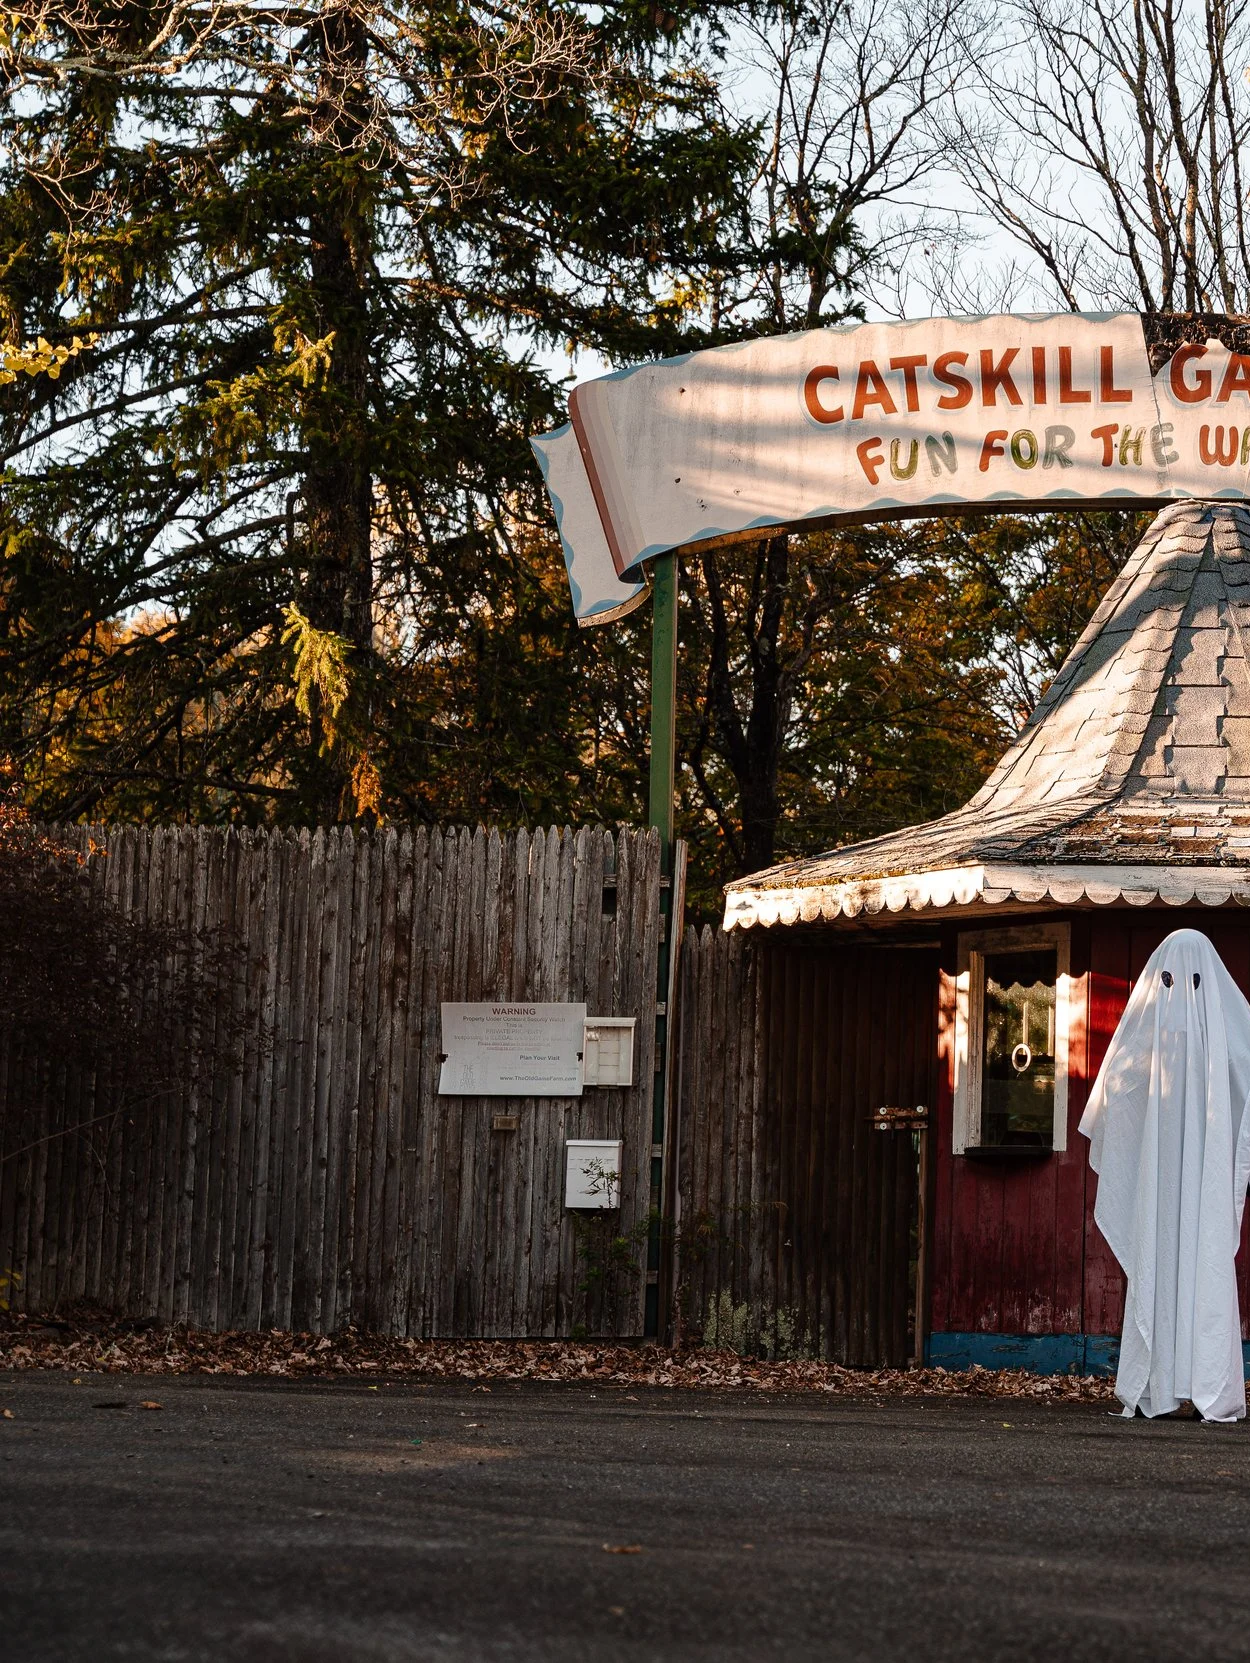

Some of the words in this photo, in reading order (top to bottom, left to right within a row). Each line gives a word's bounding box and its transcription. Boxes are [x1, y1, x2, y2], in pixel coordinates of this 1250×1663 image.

[803, 345, 1133, 425] CATSKILL
[856, 429, 958, 486] FUN
[979, 423, 1076, 473] FOR
[1090, 422, 1180, 469] THE
[491, 1007, 536, 1016] WARNING
